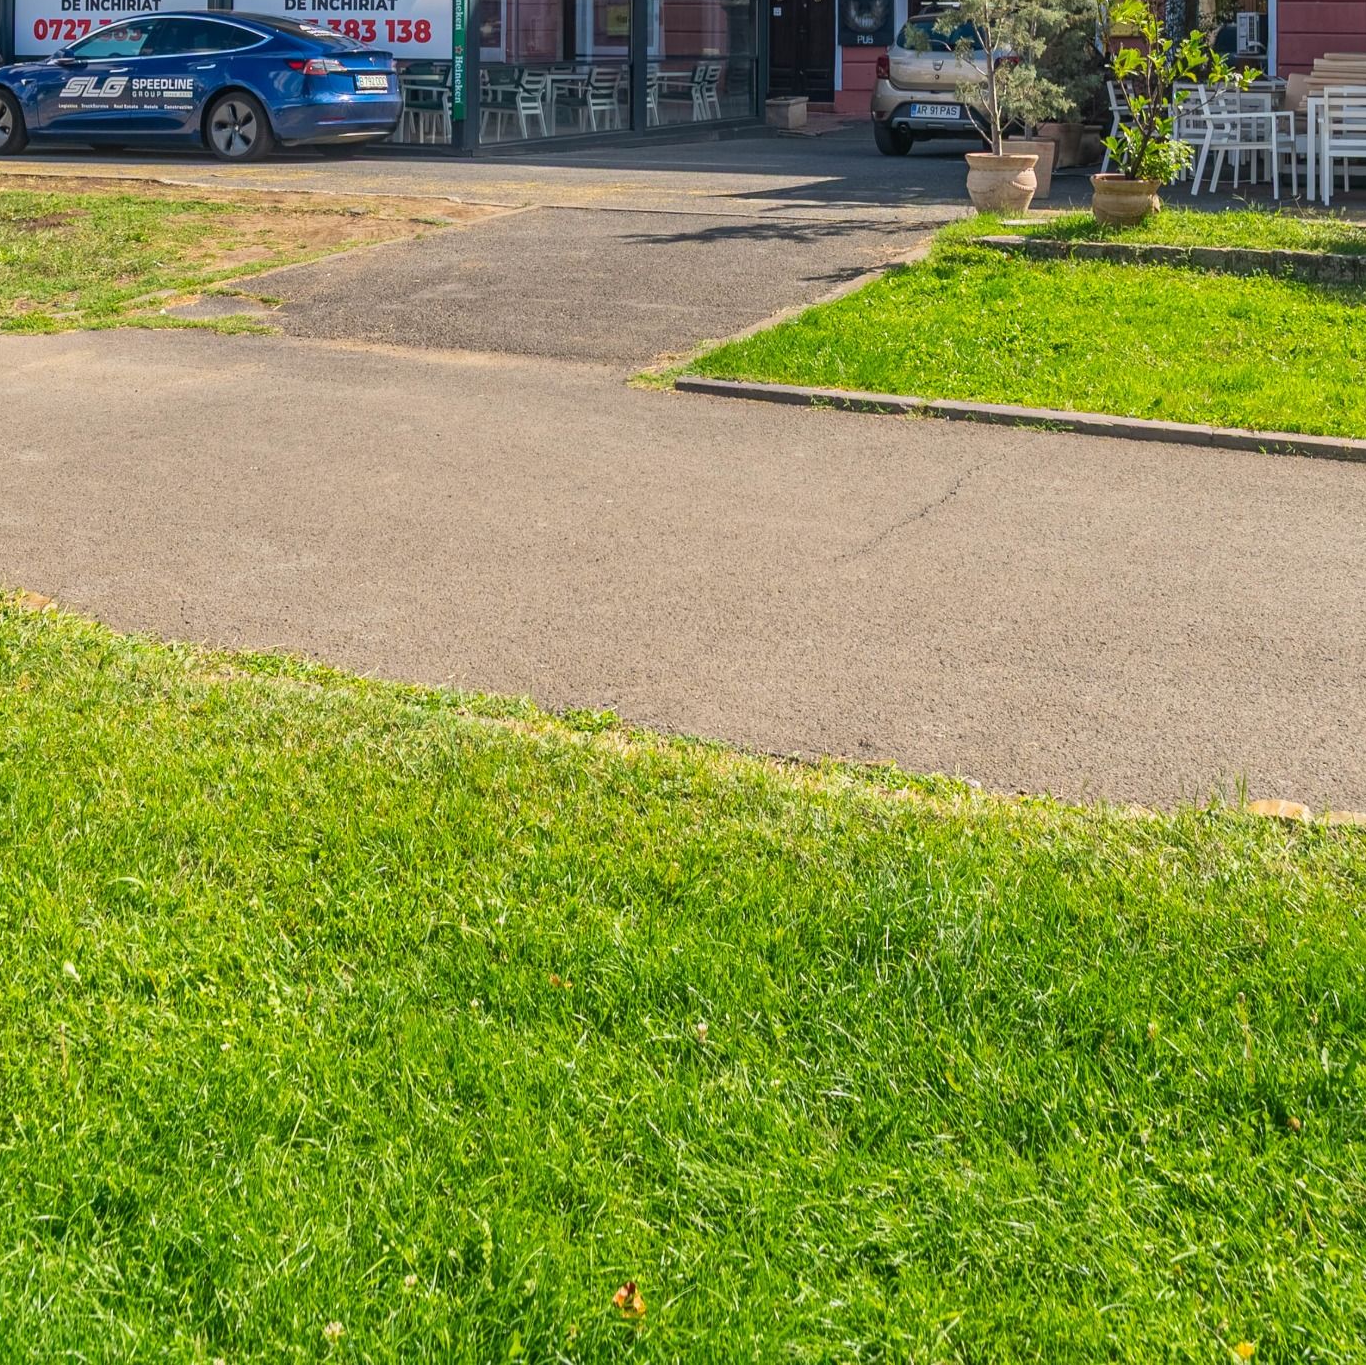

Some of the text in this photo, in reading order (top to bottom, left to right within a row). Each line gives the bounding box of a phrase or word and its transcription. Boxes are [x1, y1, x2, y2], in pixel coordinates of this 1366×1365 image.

[33, 19, 91, 40] 0727
[327, 19, 376, 42] 383
[385, 19, 432, 43] 138
[59, 76, 194, 98] SLG SPEEDLINE
[454, 55, 463, 103] Heineken
[916, 106, 958, 115] AR 91 PAS
